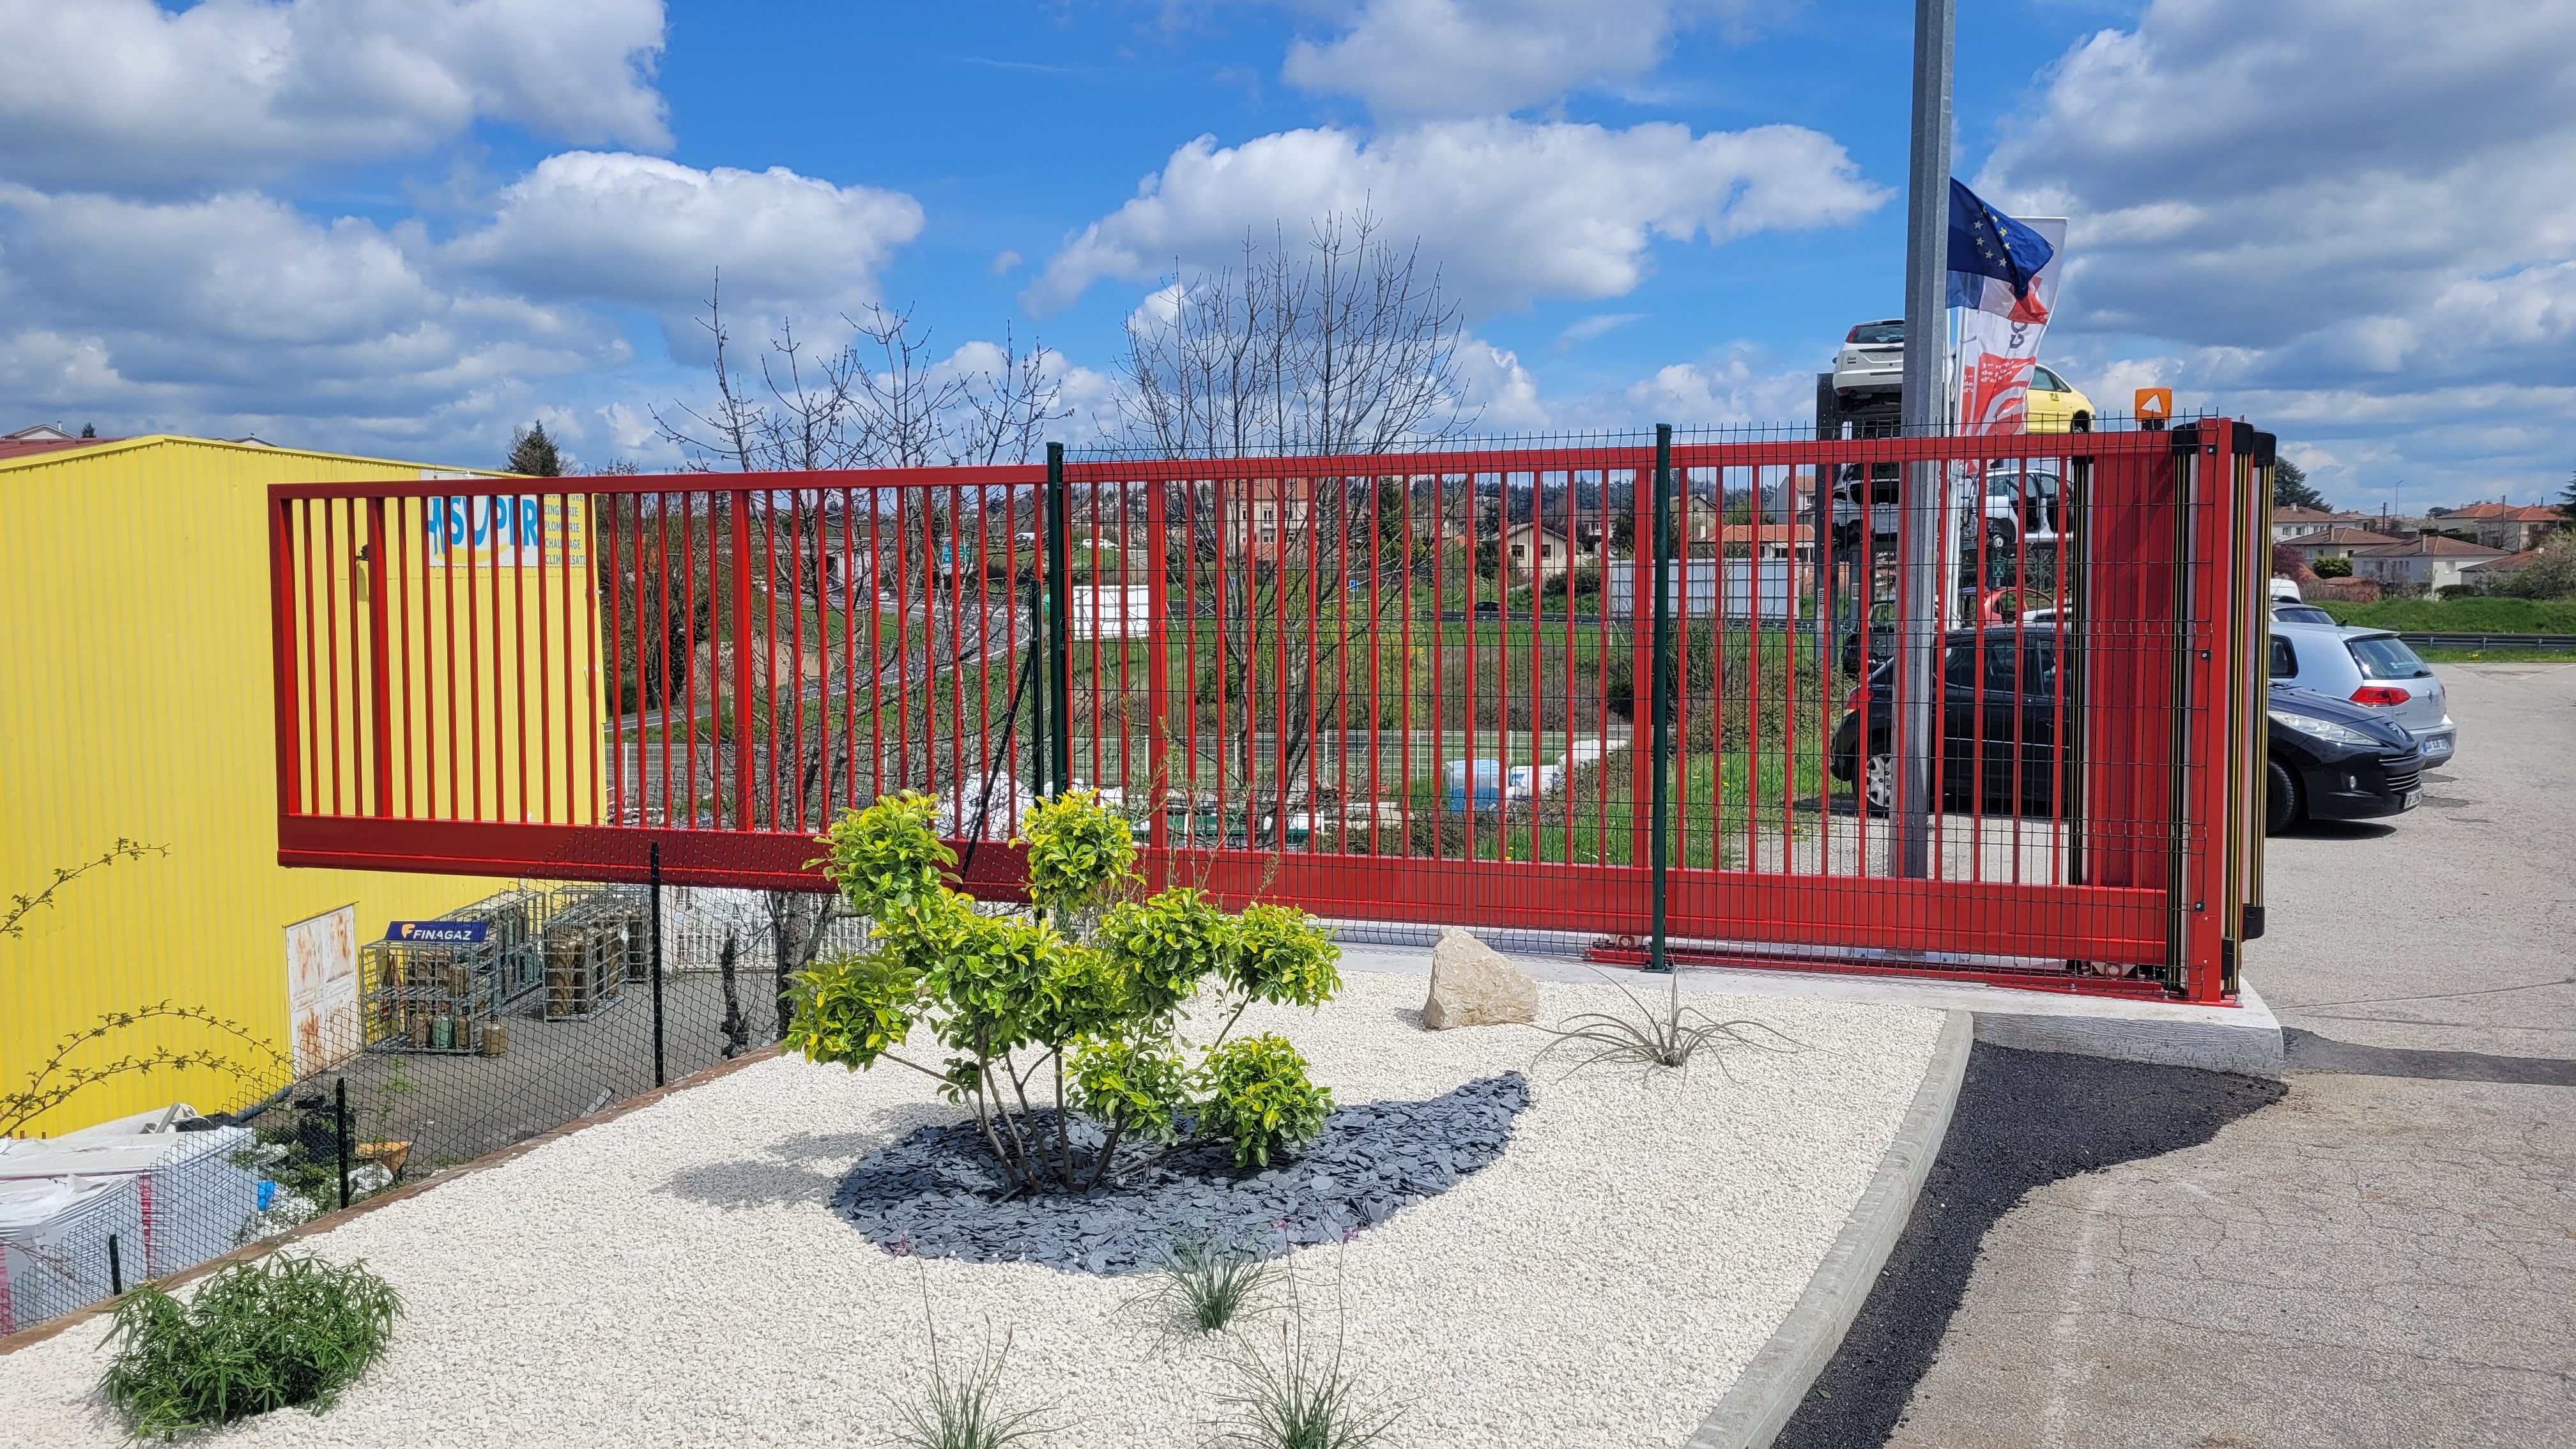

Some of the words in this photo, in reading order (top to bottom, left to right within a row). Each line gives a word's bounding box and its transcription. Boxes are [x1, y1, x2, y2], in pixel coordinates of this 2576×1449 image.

[544, 504, 578, 517] ZINGRIE
[544, 521, 580, 533] PLOMRIE
[413, 930, 472, 940] FINAGAZ
